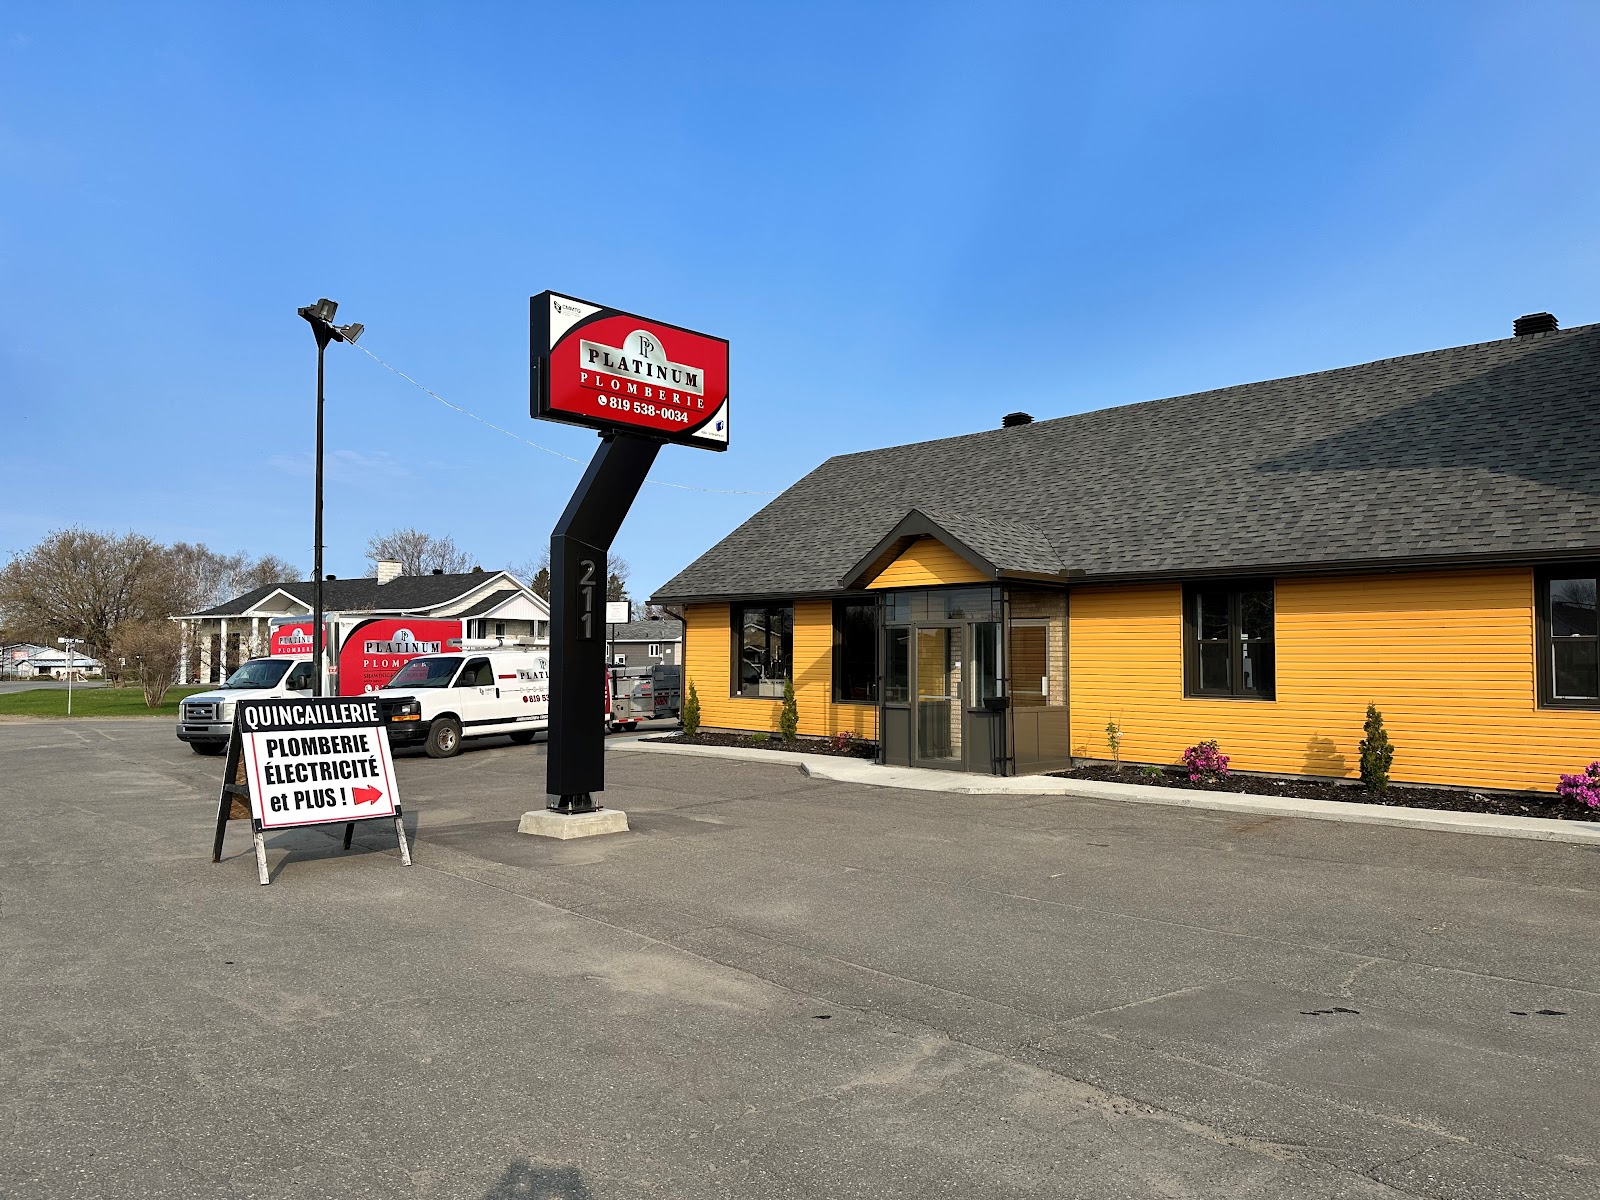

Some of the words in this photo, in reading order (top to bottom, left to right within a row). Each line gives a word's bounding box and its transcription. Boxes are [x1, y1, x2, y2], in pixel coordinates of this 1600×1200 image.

[588, 348, 698, 387] PLATINUM
[580, 371, 704, 409] PLOMBERIE
[609, 396, 630, 411] 819
[633, 402, 688, 423] 538-0034
[580, 559, 596, 638] 211
[278, 646, 313, 654] PLOMBERI
[279, 636, 313, 644] PLATINU
[366, 642, 440, 653] PLATINUM
[520, 671, 550, 680] PLATI
[528, 694, 541, 703] 819
[244, 703, 380, 729] QUINCAILLERIE
[265, 734, 370, 758] PLOMBERIE
[264, 755, 380, 785] ÉLECTRICITÉ
[270, 792, 290, 812] et
[293, 787, 336, 810] PLUS
[340, 787, 347, 806] !
